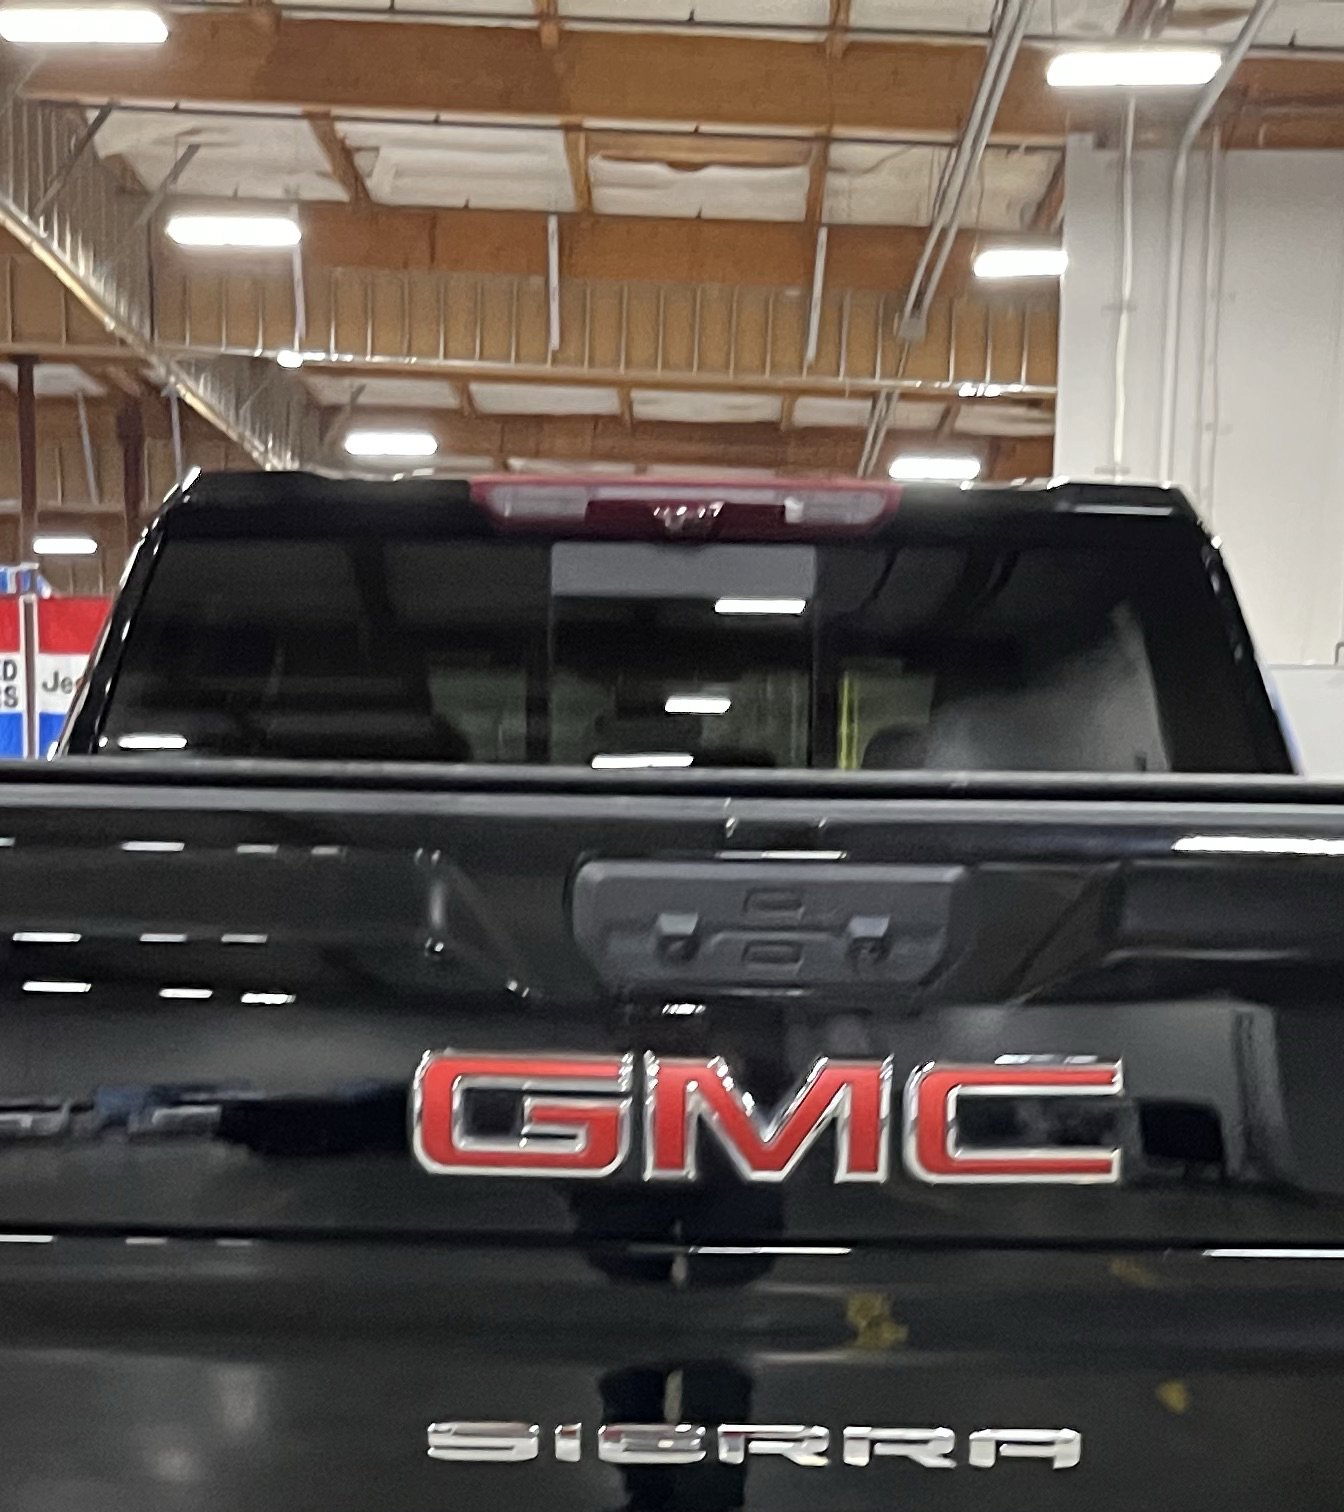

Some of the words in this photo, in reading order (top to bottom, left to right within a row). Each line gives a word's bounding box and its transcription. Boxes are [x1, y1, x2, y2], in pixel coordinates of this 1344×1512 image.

[42, 670, 73, 695] Je
[412, 1050, 1124, 1185] GMC
[425, 1420, 1083, 1470] SIERRA
